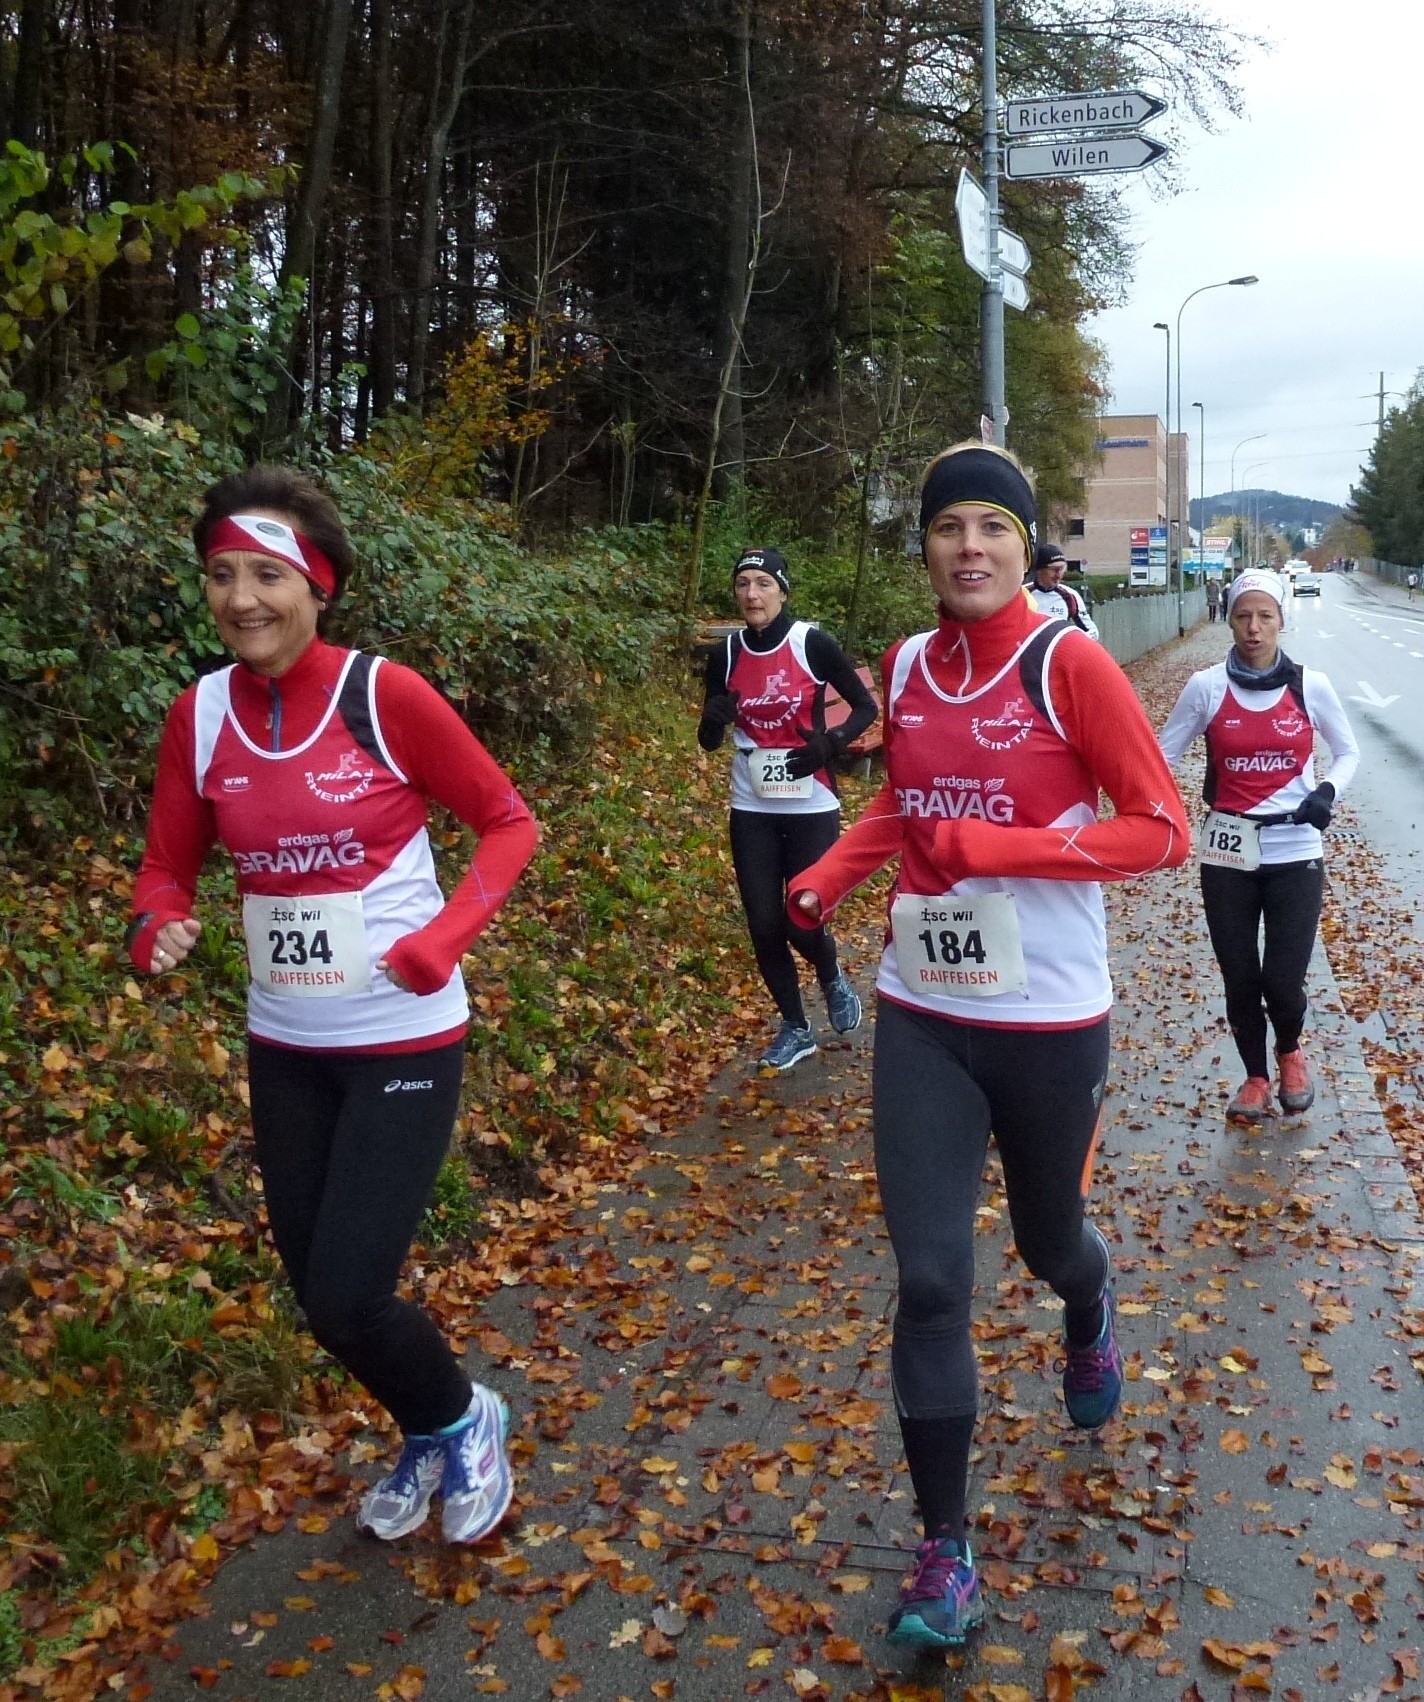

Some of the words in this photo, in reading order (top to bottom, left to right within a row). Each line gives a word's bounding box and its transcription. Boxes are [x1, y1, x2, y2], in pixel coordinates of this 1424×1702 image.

[1019, 100, 1134, 127] Rickenbach
[1052, 148, 1109, 167] Wilen
[970, 717, 1034, 751] RHEINTAL
[1224, 756, 1297, 772] GRAVAG
[304, 768, 374, 803] RHEINTAL
[760, 784, 801, 793] RAIFFEISEN
[932, 774, 981, 790] erdgas
[277, 833, 330, 847] erdgas
[1208, 829, 1242, 854] 182
[1201, 849, 1245, 864] RAIFFEISEN
[268, 929, 334, 966] 234
[918, 929, 987, 965] 184
[269, 969, 345, 986] RAIFFEISEN
[919, 968, 999, 985] RAIFFEISEN
[401, 1079, 434, 1090] asics
